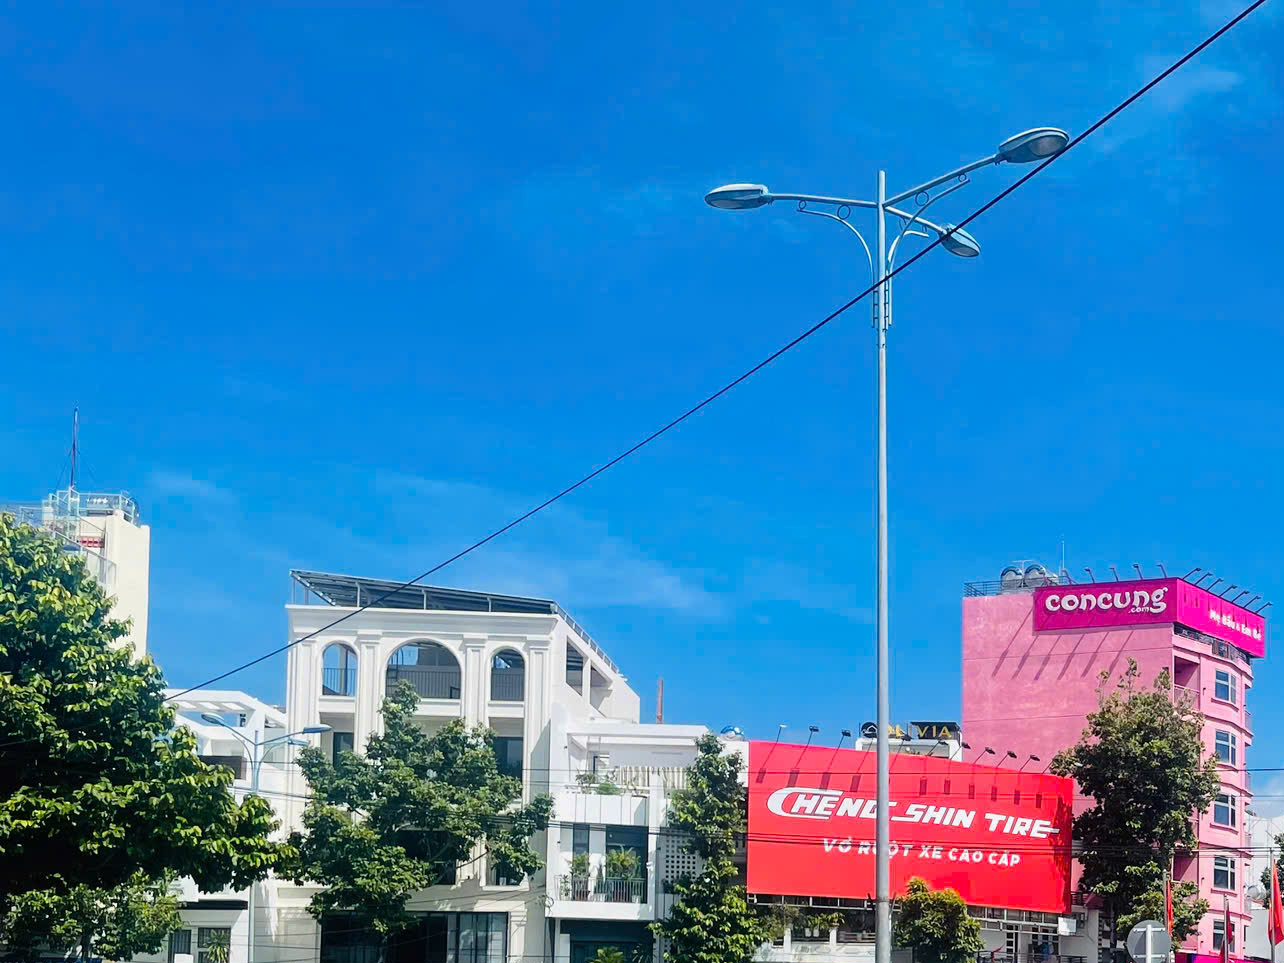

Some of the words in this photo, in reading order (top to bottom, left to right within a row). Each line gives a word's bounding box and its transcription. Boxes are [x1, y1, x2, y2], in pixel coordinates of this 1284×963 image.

[1046, 588, 1168, 614] concung
[892, 804, 976, 828] SHIN
[984, 812, 1060, 838] TIRE
[858, 840, 913, 860] RỘT
[919, 845, 942, 860] XE
[948, 848, 984, 863] CAO
